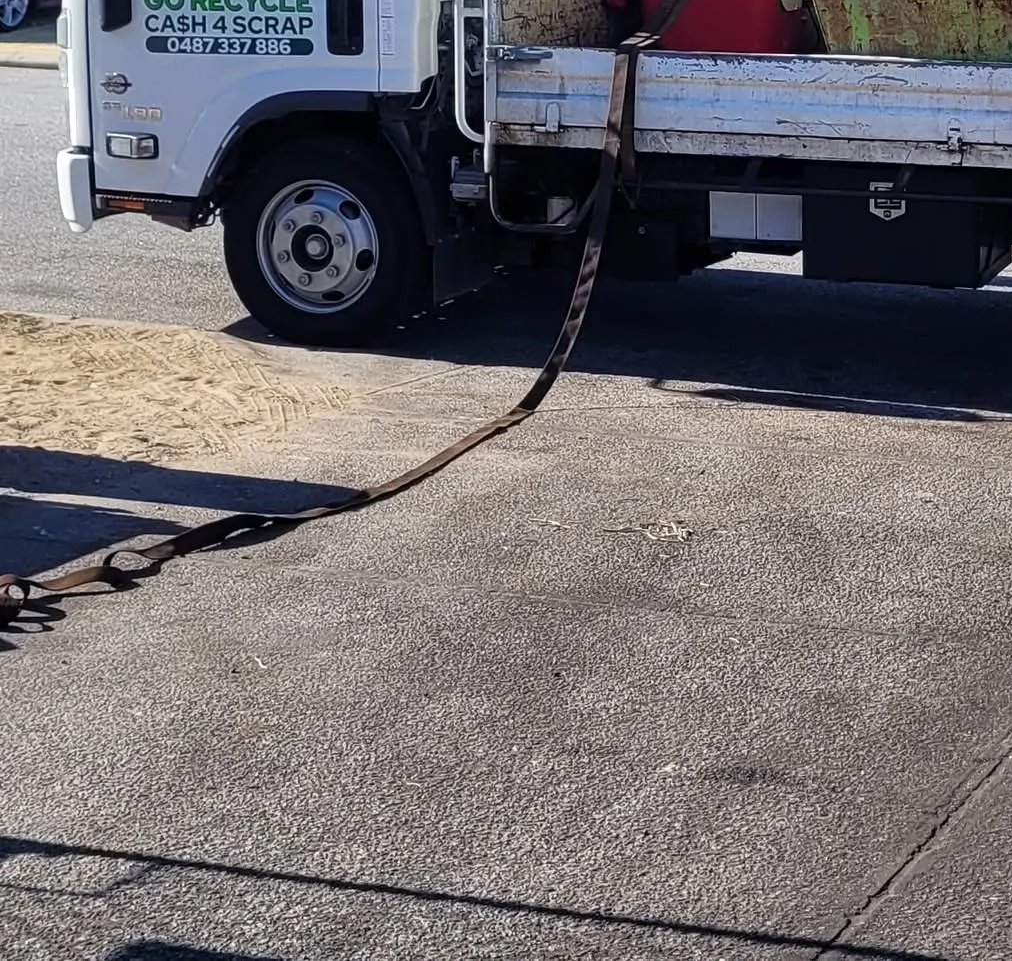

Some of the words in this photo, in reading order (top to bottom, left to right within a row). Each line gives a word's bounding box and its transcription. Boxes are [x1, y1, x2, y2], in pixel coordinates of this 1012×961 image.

[144, 13, 207, 35] CA$H
[212, 15, 227, 34] 4
[232, 15, 313, 35] SCRAP
[167, 37, 215, 53] 0487
[217, 38, 251, 54] 337
[255, 39, 292, 55] 886
